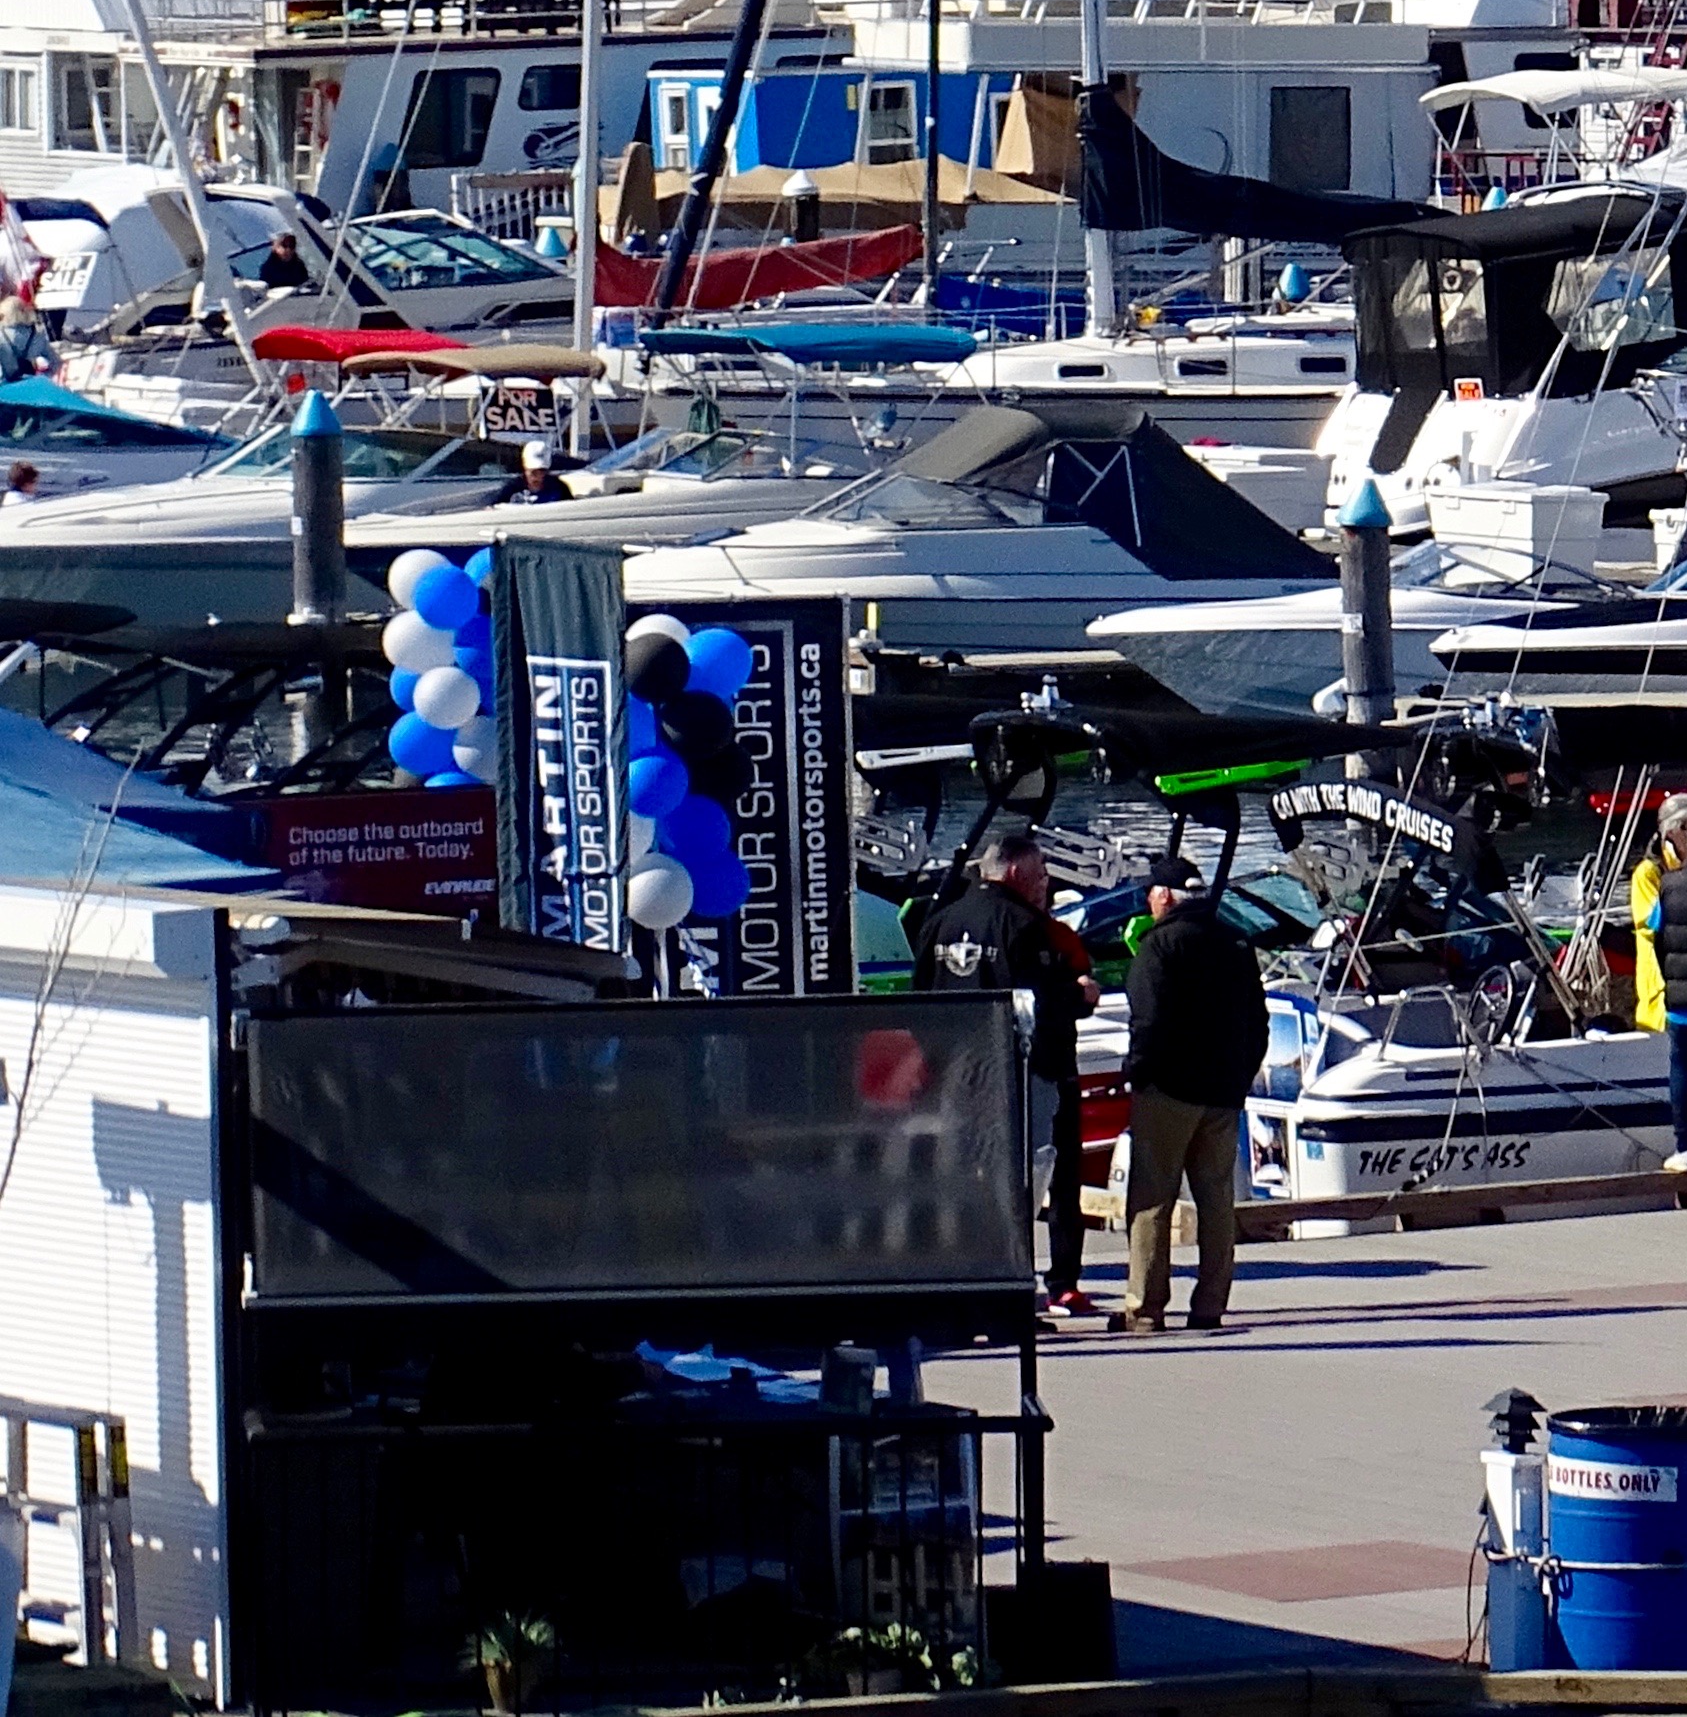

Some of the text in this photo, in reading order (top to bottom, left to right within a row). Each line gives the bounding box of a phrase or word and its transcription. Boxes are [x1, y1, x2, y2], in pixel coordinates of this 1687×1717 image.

[498, 386, 538, 407] FOR
[486, 406, 557, 431] SALE
[535, 673, 571, 943] MARTIN
[571, 676, 611, 950] MOOR SPORTS
[797, 642, 830, 982] martinmotorsports.ca
[1272, 783, 1454, 853] GO WITH THE WIND CRUISES
[289, 817, 484, 845] Choose the outboard
[289, 841, 475, 866] of the future. Today.
[1359, 1148, 1406, 1176] THE
[1482, 1141, 1531, 1169] ASS
[1556, 1466, 1613, 1490] BOTTLES
[1619, 1472, 1661, 1493] ONLY
